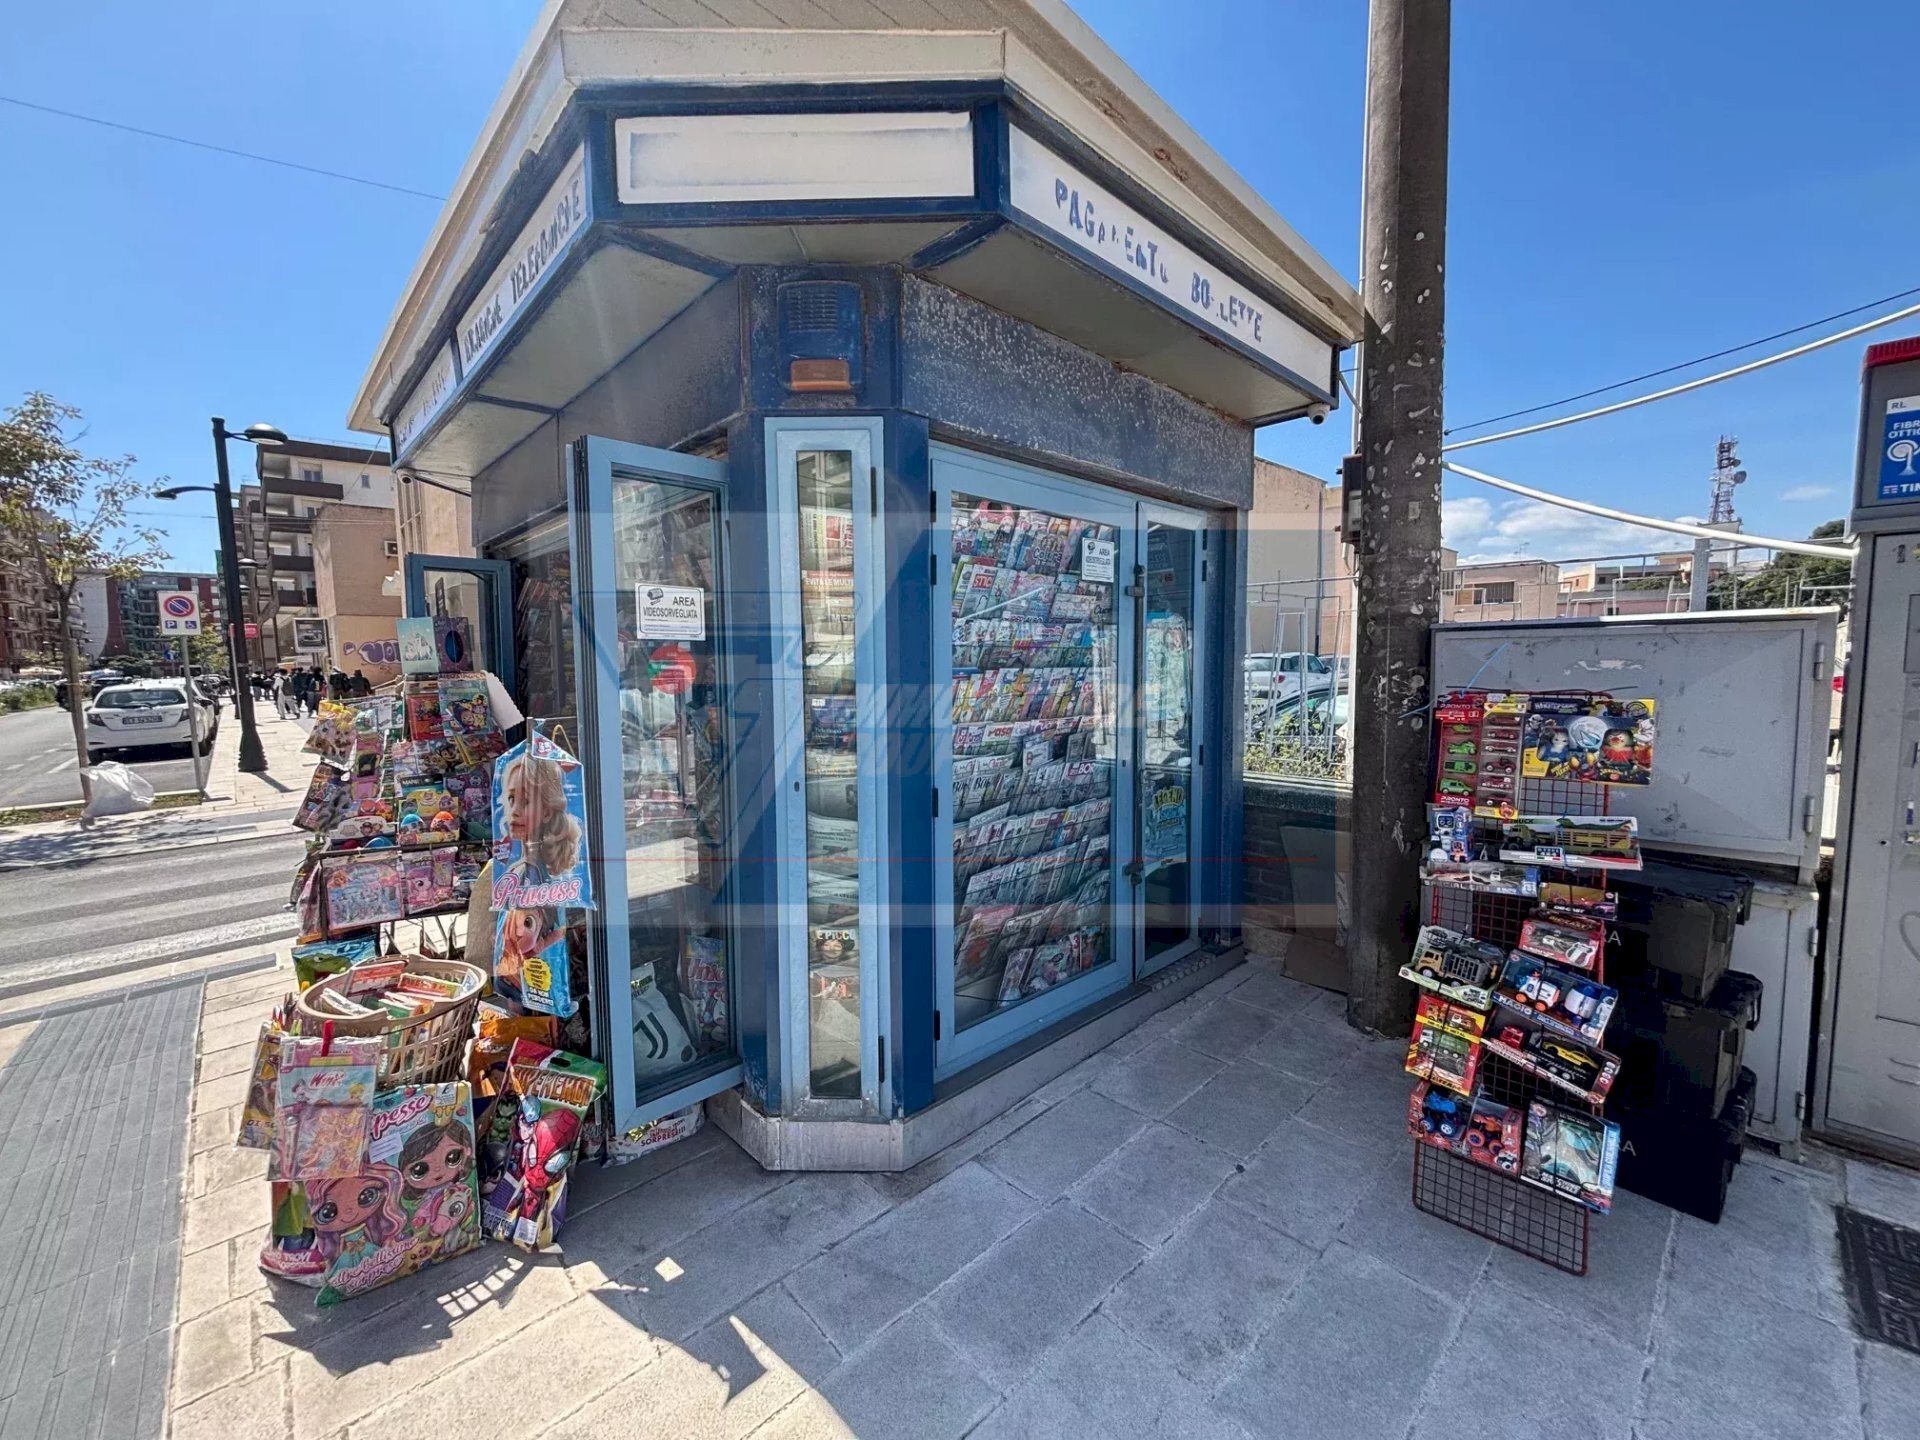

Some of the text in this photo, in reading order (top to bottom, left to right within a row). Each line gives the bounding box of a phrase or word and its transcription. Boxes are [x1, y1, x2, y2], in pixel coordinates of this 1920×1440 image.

[672, 596, 696, 607] AREA
[643, 606, 698, 619] VIDEOSORVEGLIATA
[493, 872, 583, 909] Princess
